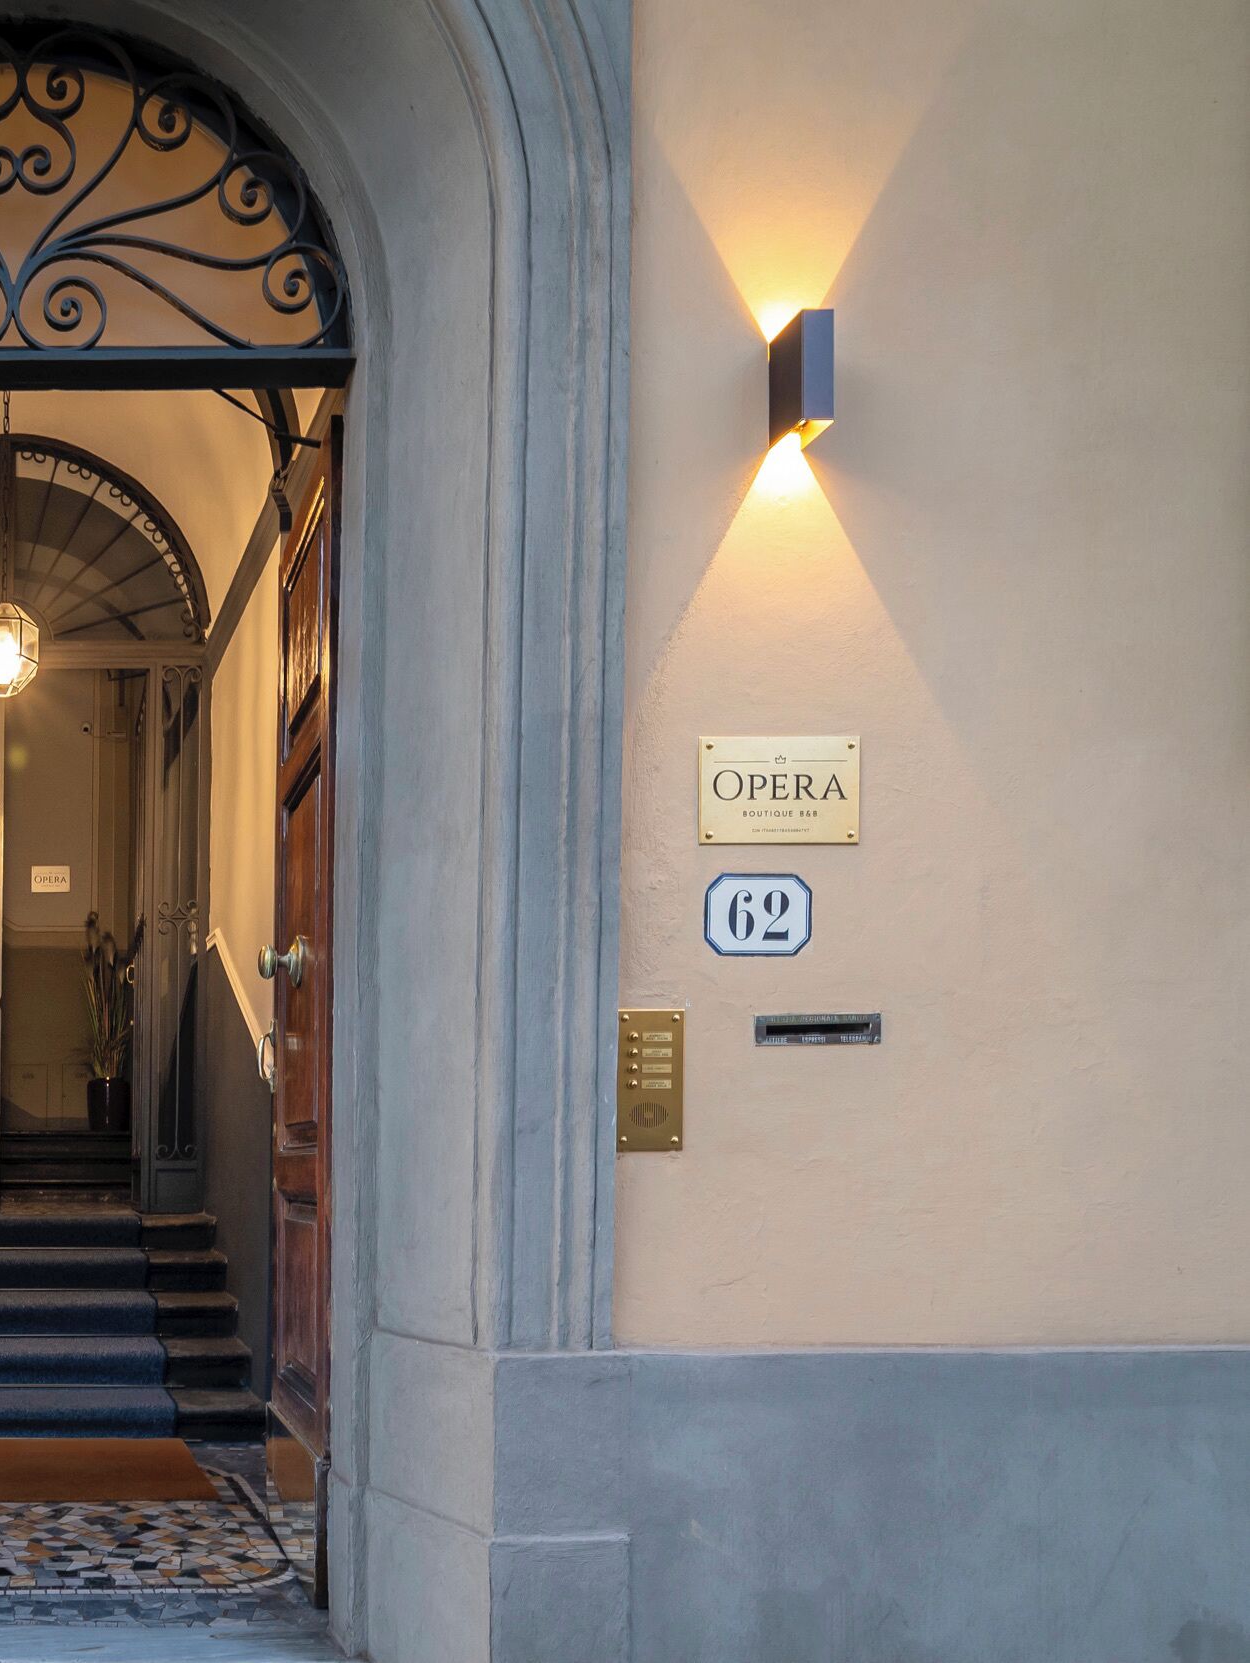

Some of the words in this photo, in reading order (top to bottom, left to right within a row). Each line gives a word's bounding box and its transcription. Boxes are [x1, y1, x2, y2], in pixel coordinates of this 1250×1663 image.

[712, 769, 848, 801] OPERA
[742, 810, 793, 818] BOUTIQUE
[799, 810, 818, 818] B&B
[34, 875, 67, 884] OPERA
[728, 889, 790, 941] 62
